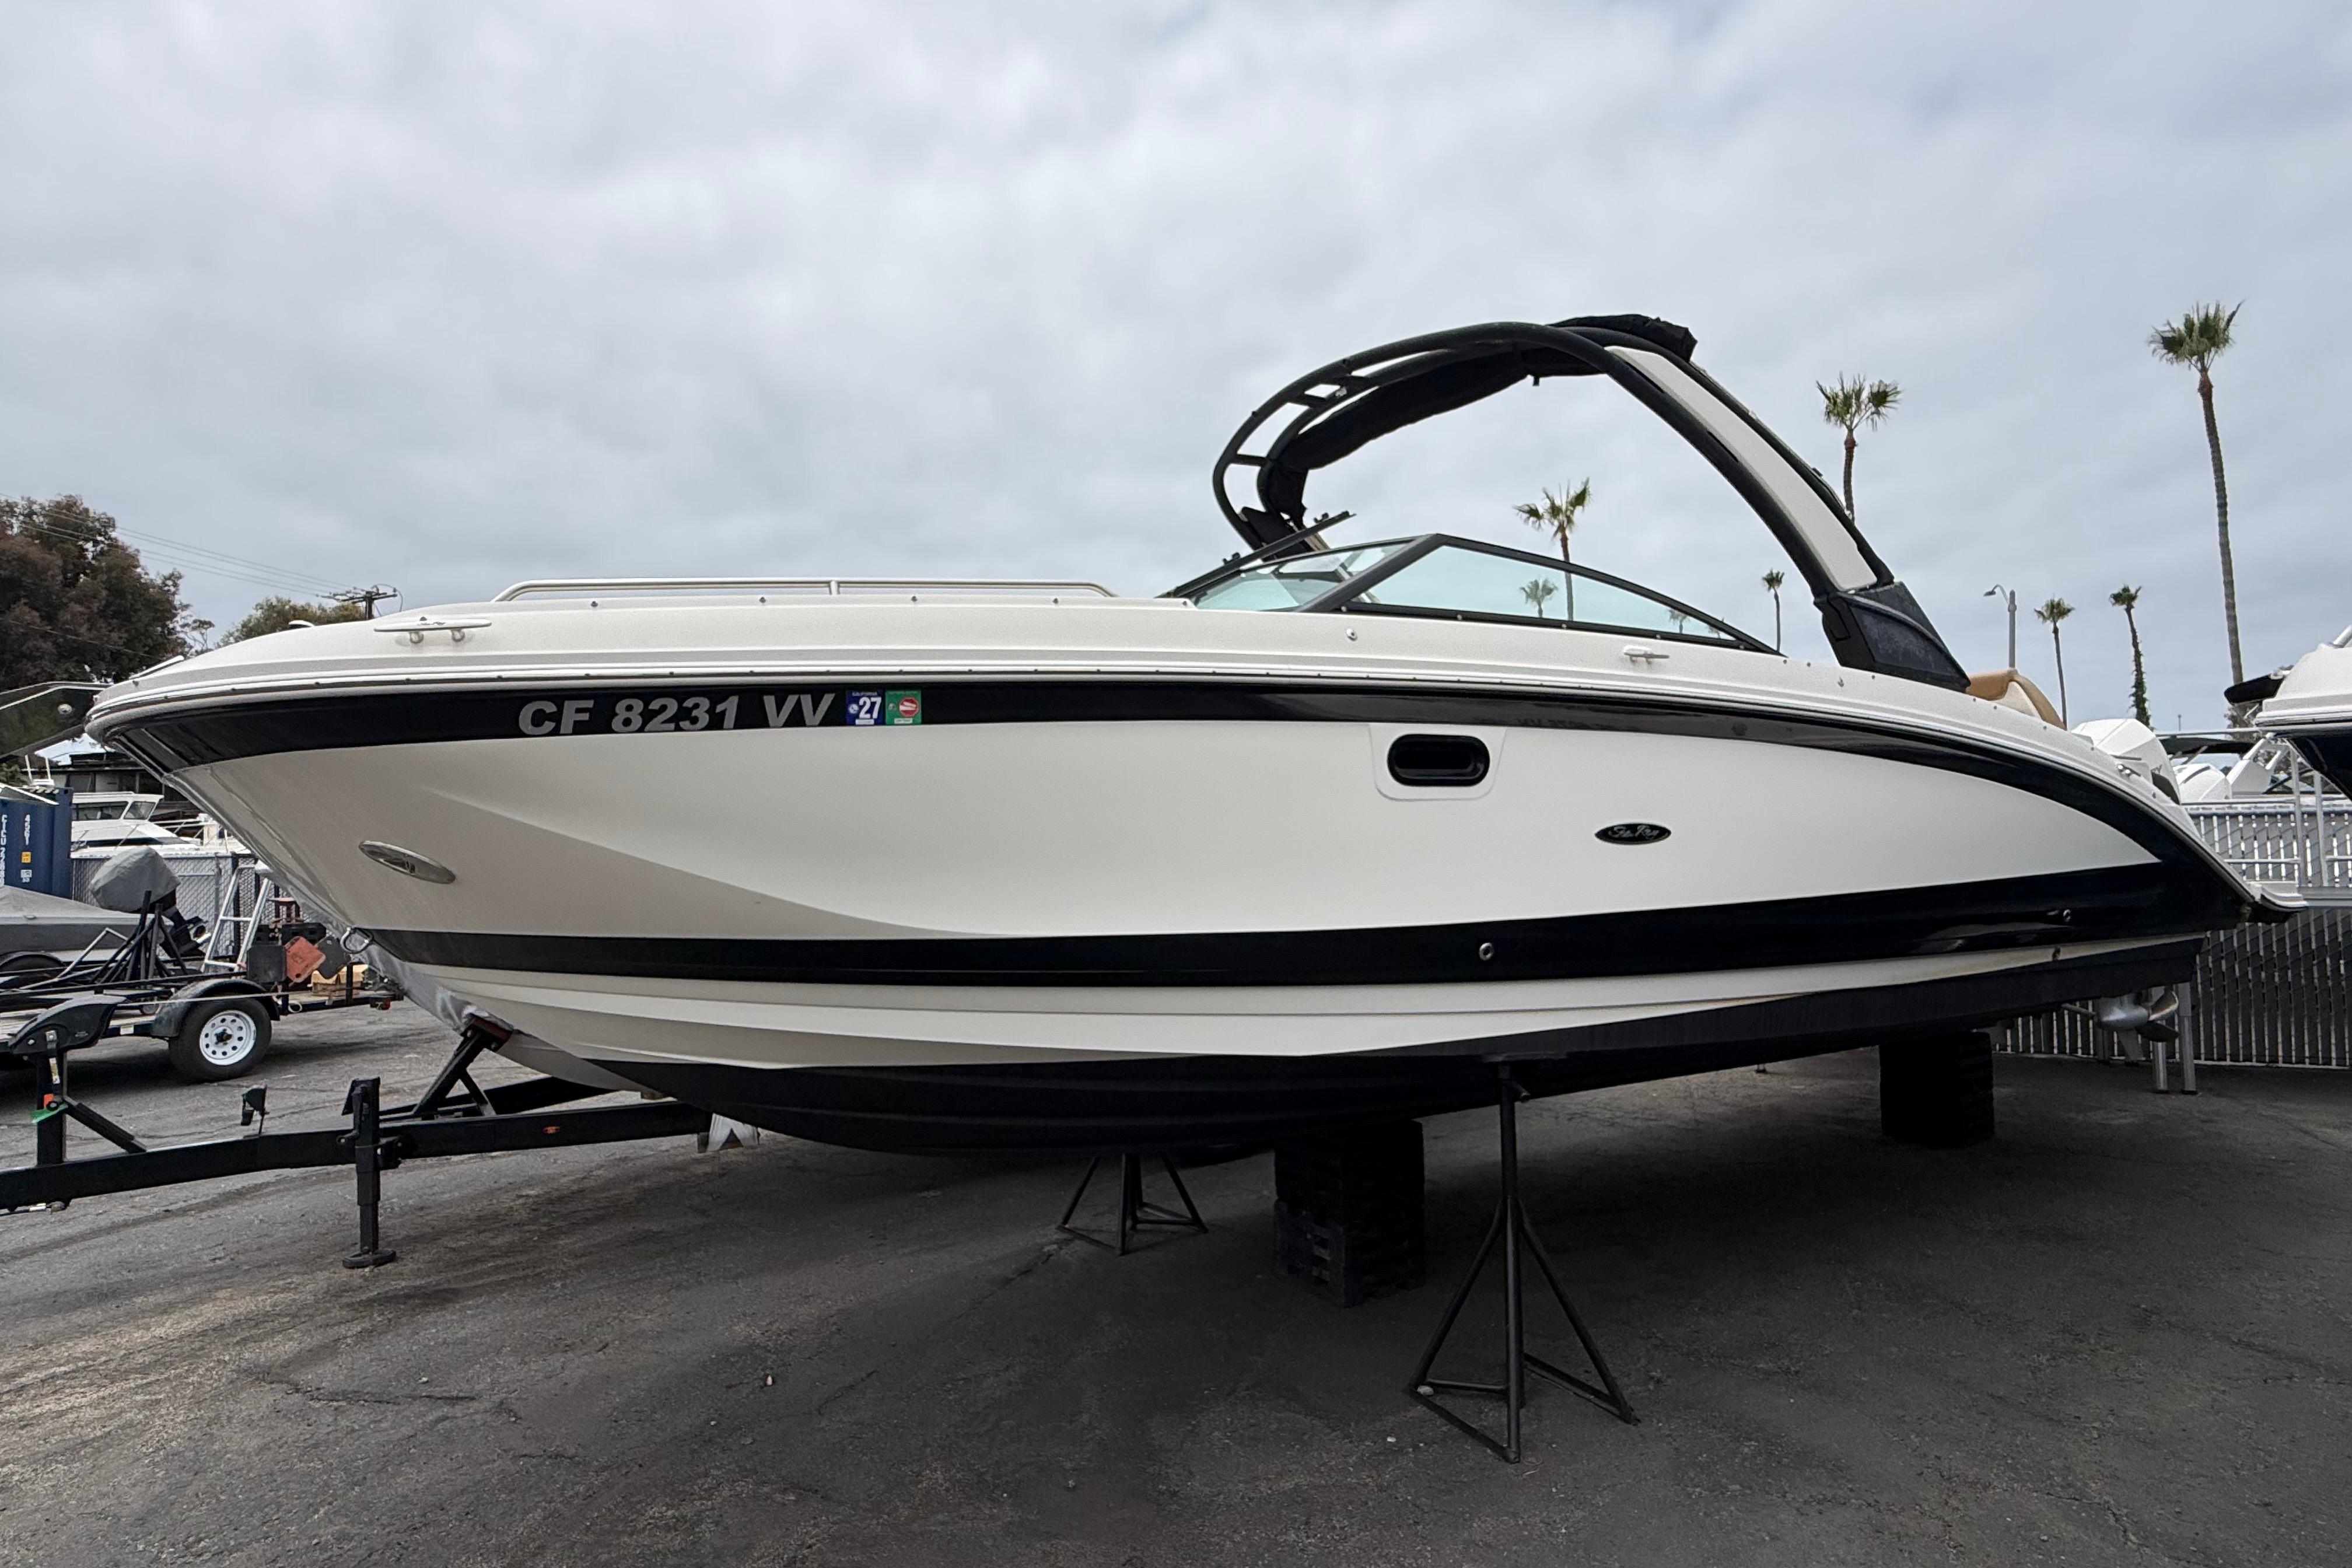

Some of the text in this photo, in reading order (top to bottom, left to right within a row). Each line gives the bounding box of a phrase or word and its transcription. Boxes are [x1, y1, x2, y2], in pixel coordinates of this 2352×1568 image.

[518, 693, 836, 736] CF 8231 VV
[859, 696, 882, 719] 27
